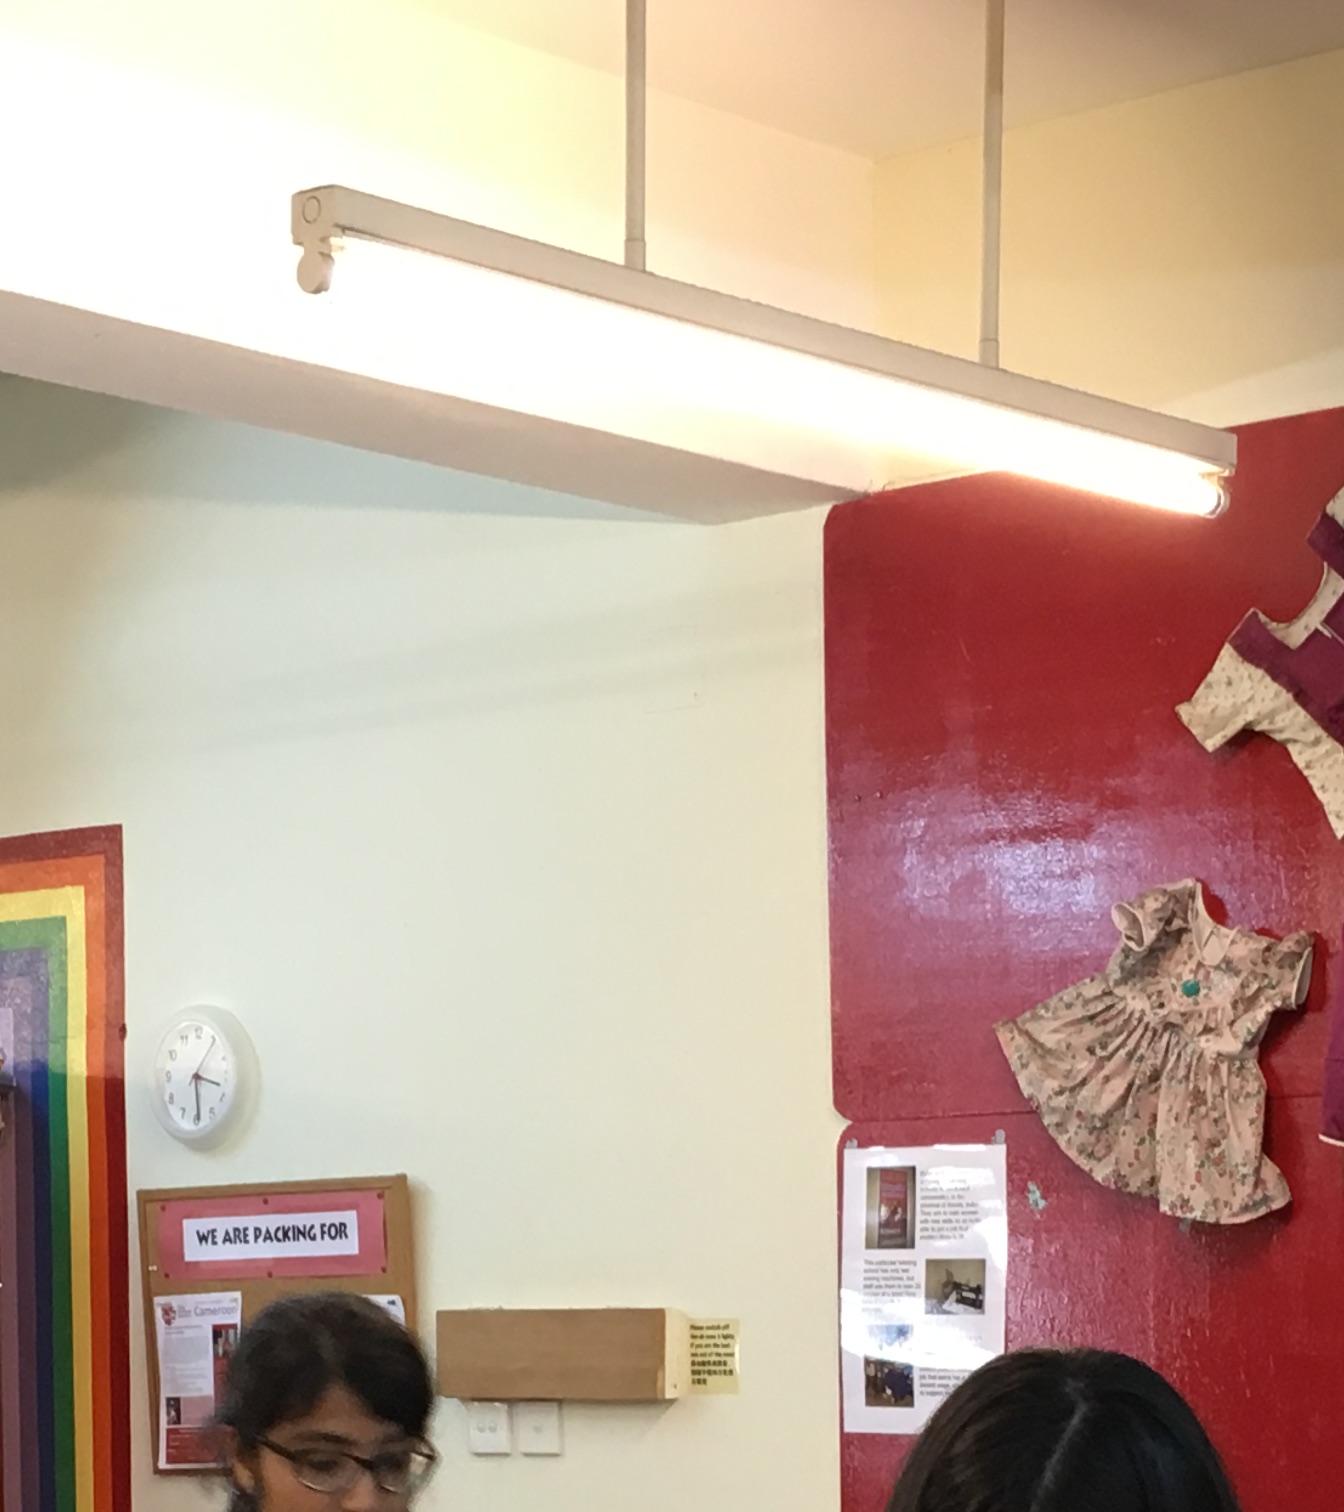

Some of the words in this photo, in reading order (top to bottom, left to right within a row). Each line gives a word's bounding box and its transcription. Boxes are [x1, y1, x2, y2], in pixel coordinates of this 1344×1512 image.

[196, 1228, 218, 1247] WE
[222, 1226, 250, 1246] ARE
[253, 1223, 317, 1245] PACKING
[320, 1222, 349, 1241] FOR
[194, 1305, 239, 1317] Cameroon
